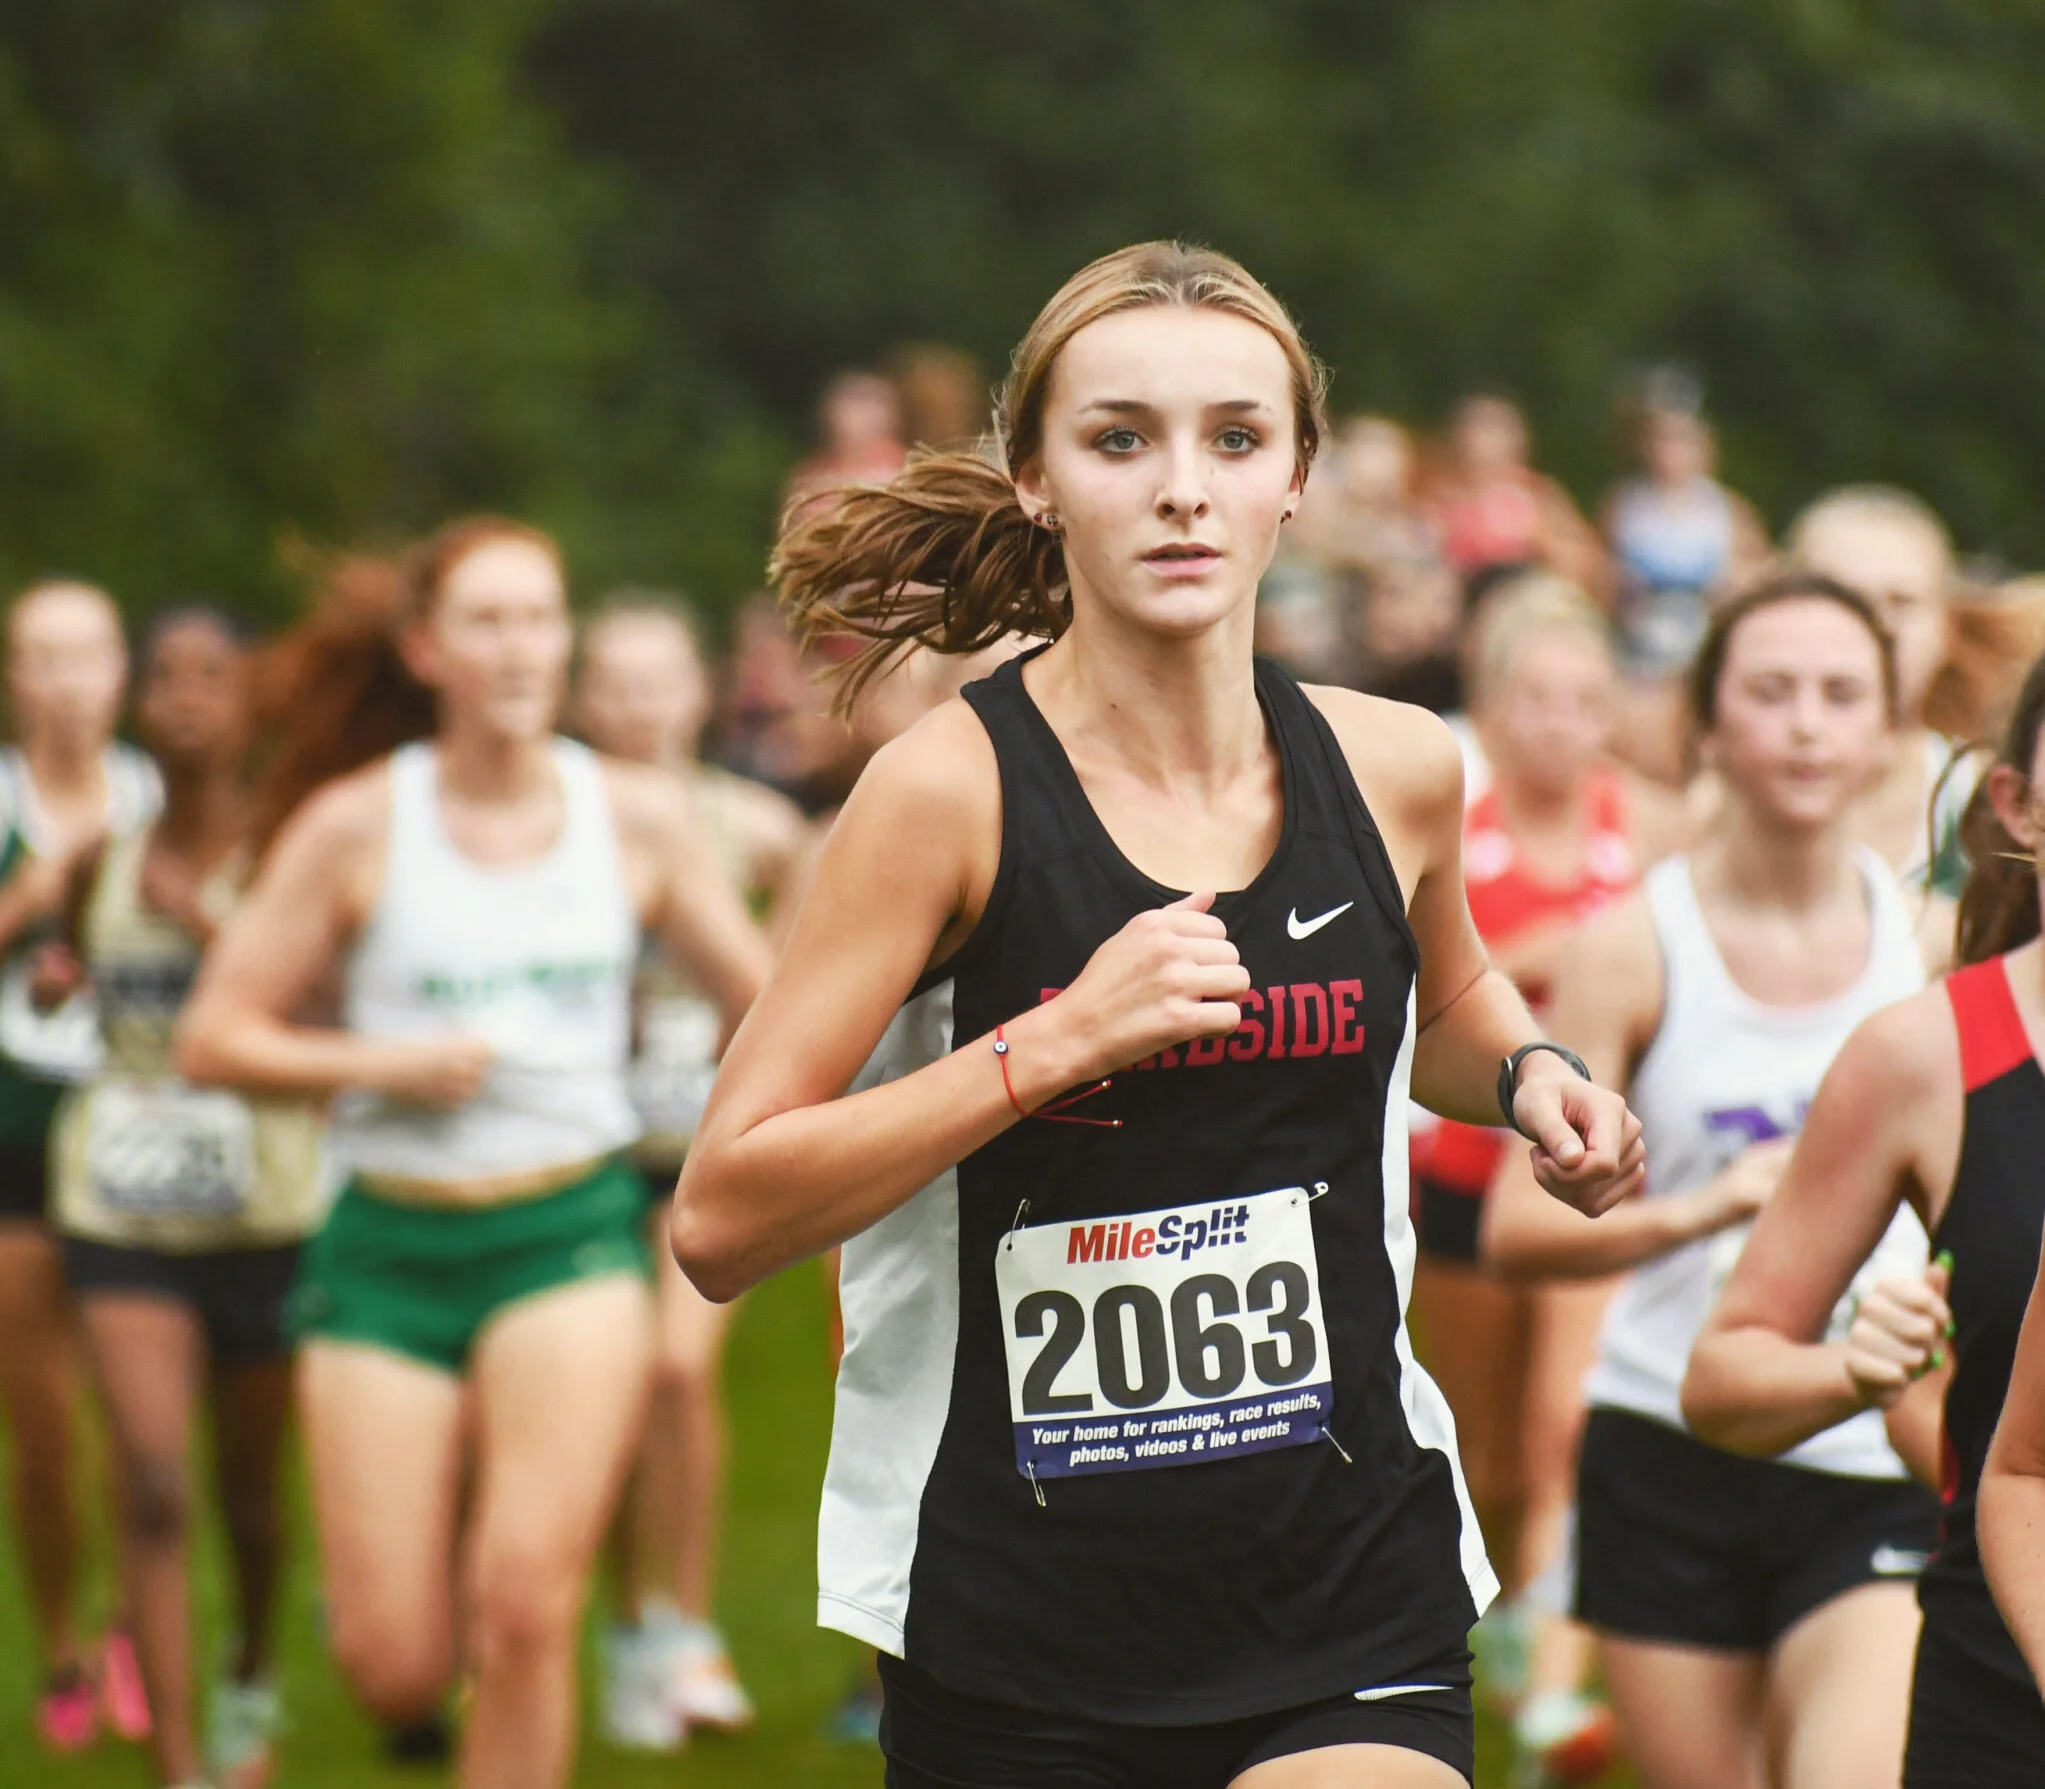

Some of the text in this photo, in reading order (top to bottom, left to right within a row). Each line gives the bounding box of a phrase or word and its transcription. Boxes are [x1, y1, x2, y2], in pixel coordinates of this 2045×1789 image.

[1040, 979, 1365, 1072] SIDE
[1067, 1205, 1249, 1264] MileSplit
[1014, 1261, 1316, 1416] 2063
[1032, 1393, 1321, 1445] Your home for rankings, race results,
[1070, 1421, 1290, 1467] photos, videos & live events
